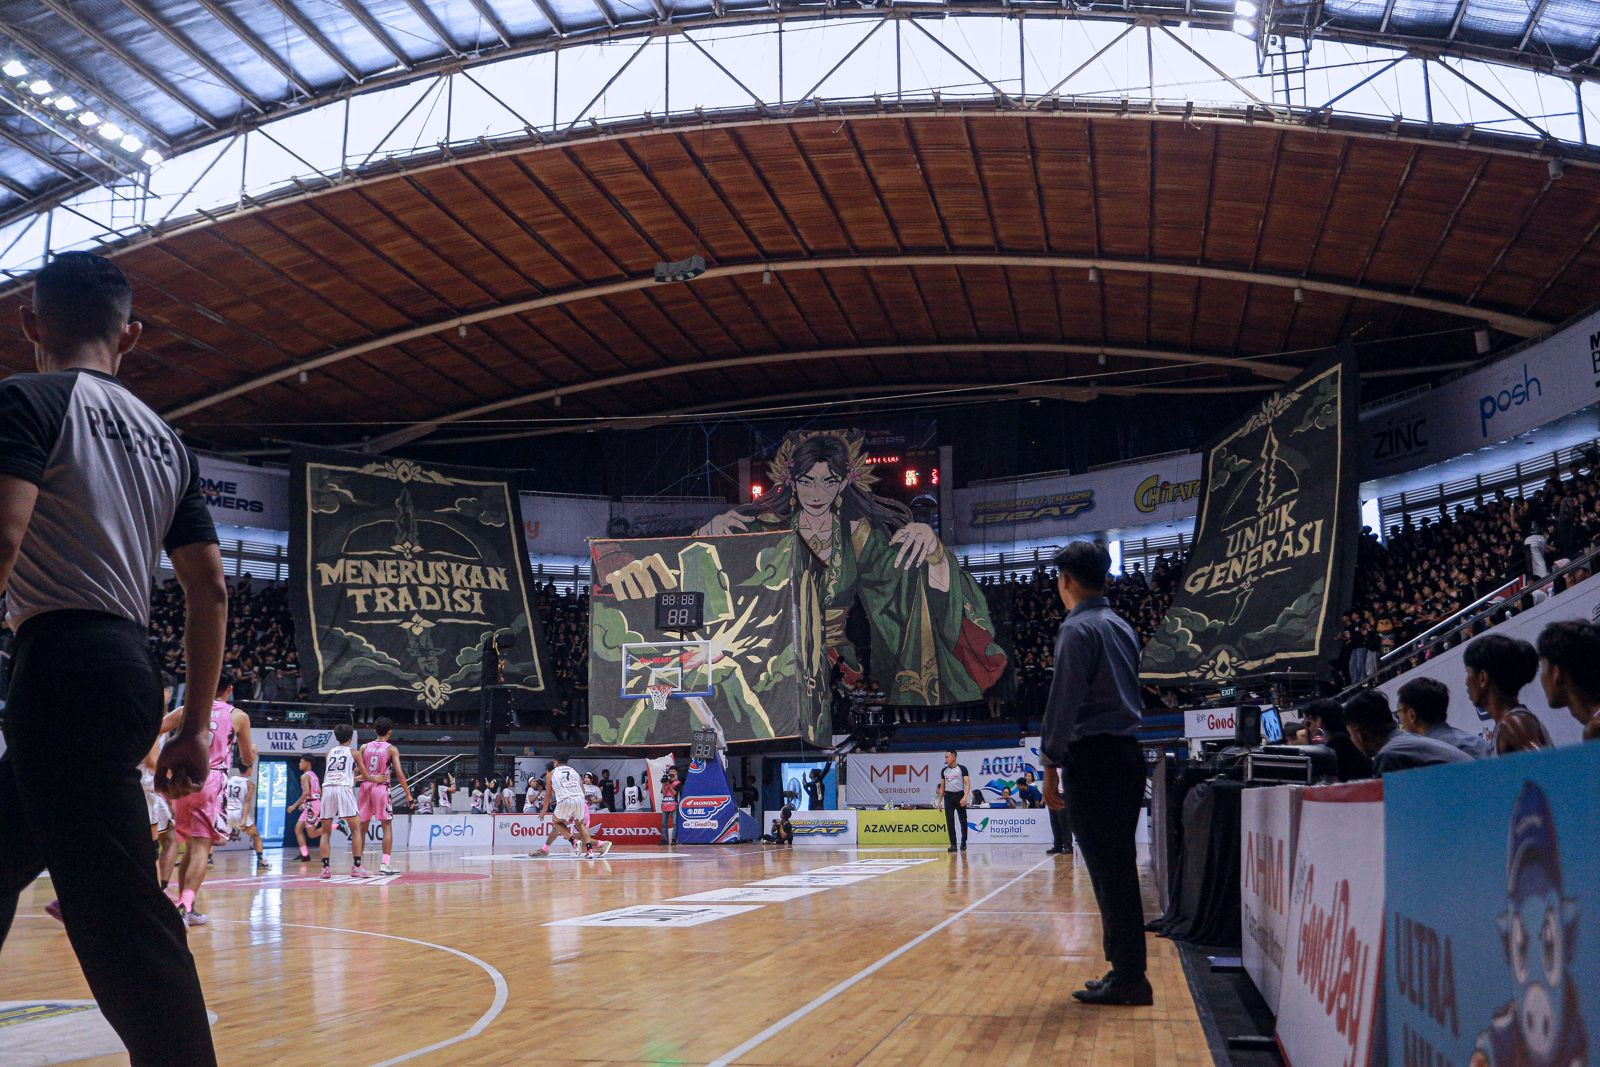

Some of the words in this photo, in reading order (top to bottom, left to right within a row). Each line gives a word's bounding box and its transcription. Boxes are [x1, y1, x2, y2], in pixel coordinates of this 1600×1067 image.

[1479, 363, 1542, 438] posh
[1226, 499, 1298, 558] UNTUK
[1184, 519, 1325, 597] GENERASI
[316, 558, 511, 592] MENERUSKAN
[346, 585, 487, 616] TRADISI
[1221, 688, 1236, 696] EXIT
[266, 731, 298, 741] ULTRA
[270, 741, 296, 751] MILK
[328, 755, 347, 772] 23
[368, 755, 379, 772] 9
[979, 755, 1025, 778] AQUA
[561, 770, 571, 781] 7
[870, 764, 929, 784] MPM
[228, 784, 241, 798] 13
[626, 794, 636, 807] 16
[863, 823, 947, 834] AZAWEAR.COM
[990, 817, 1036, 828] mayapada
[990, 826, 1022, 835] hospital
[428, 815, 474, 850] posh
[602, 827, 662, 837] HONDA
[1395, 911, 1460, 1038] ULTRA
